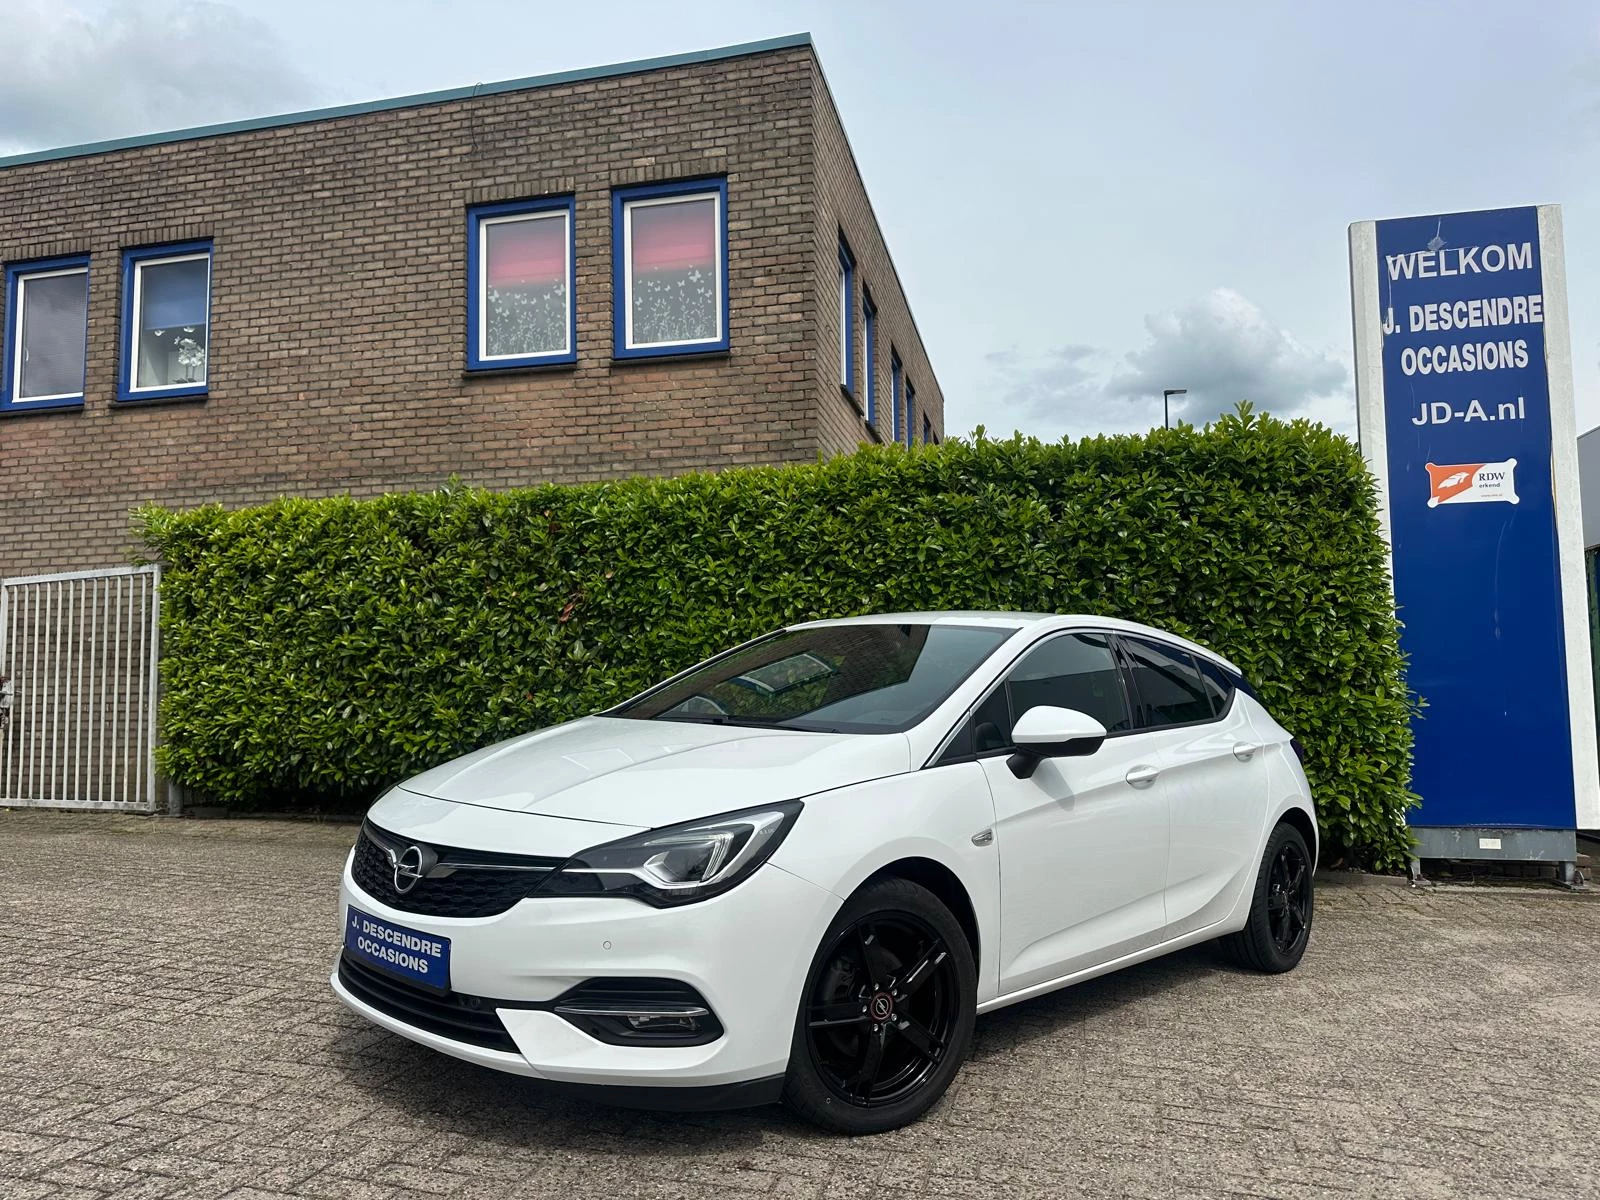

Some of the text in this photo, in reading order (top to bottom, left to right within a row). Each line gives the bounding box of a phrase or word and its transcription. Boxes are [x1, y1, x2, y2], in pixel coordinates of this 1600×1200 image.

[1386, 243, 1532, 280] WELKOM
[1383, 295, 1543, 334] J. DESCENDRE
[1401, 340, 1528, 375] OCCASIONS
[1411, 397, 1525, 426] JD-A.nl
[1479, 472, 1505, 481] RDW
[352, 916, 442, 957] J. DESCENDRE
[357, 936, 428, 973] OCCASIONS
